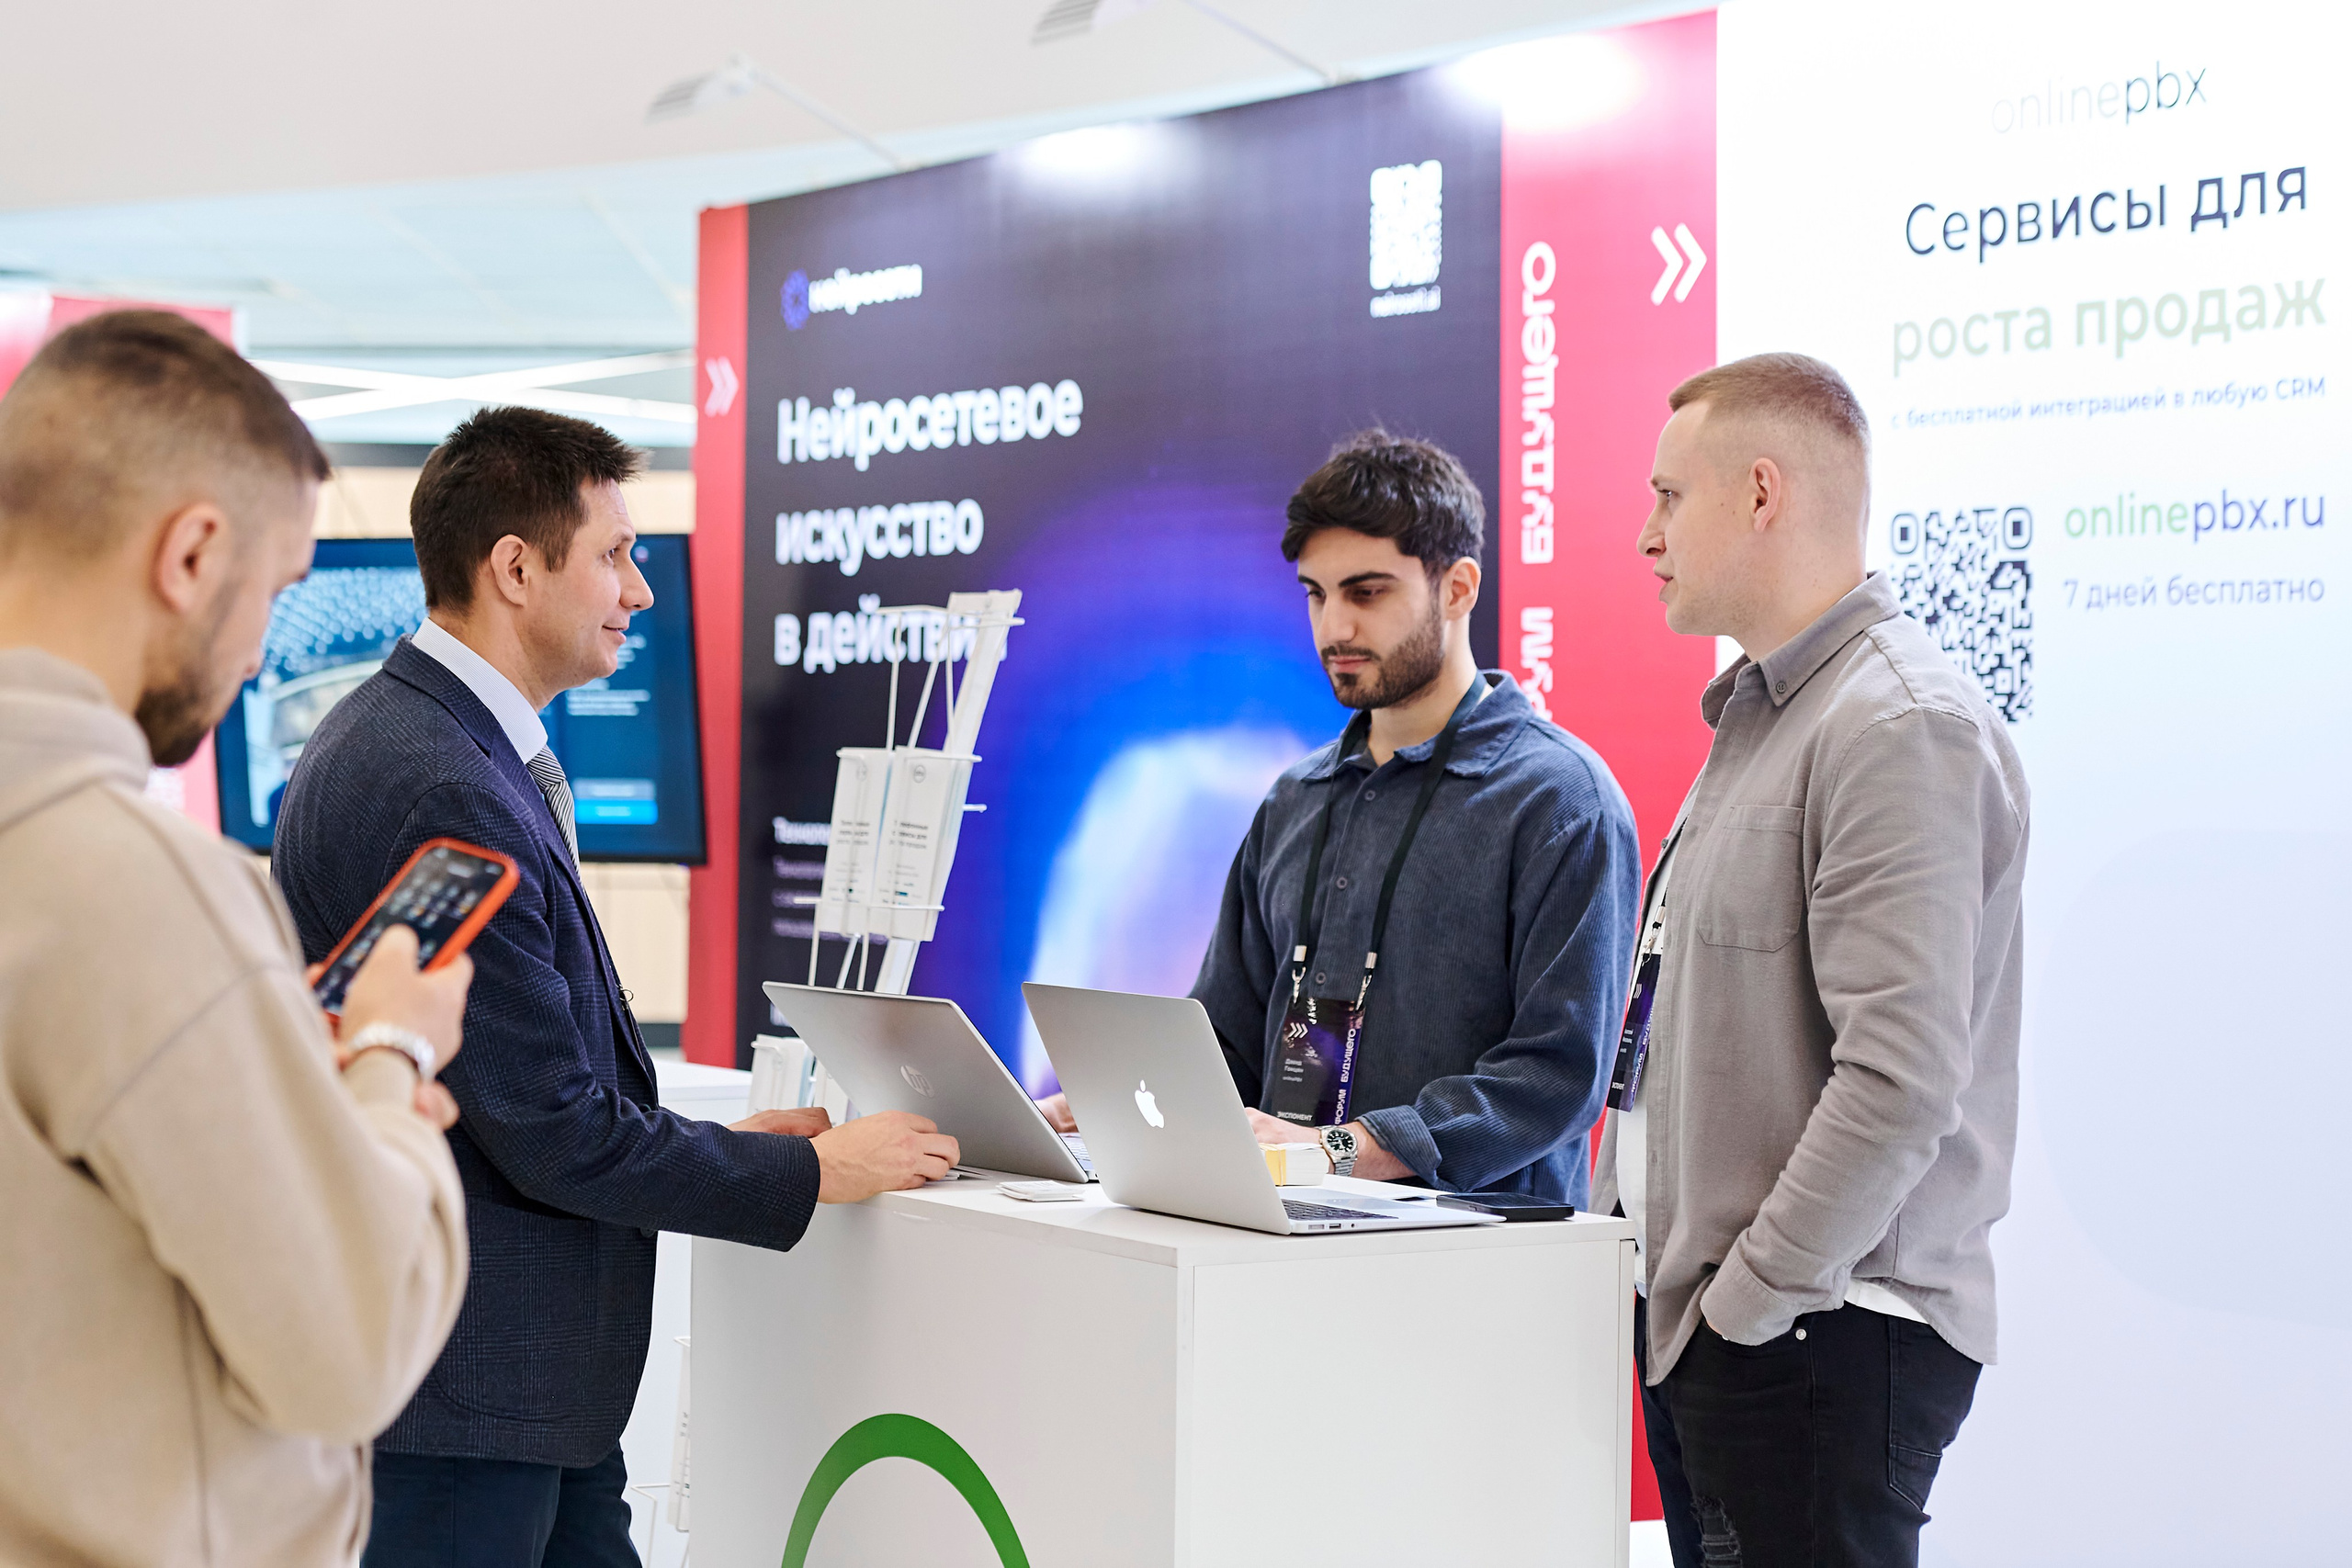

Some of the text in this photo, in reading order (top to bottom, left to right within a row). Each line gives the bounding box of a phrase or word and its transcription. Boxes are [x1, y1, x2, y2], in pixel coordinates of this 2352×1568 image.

[1991, 60, 2207, 133] onlinepbx
[1905, 166, 2306, 265] Сервисы для
[1894, 277, 2327, 378] роста продаж
[777, 379, 1084, 471] Нейросетевое
[1891, 376, 2326, 429] с бесплатной интеграцией в любую CRM
[775, 498, 985, 577] искусство
[2064, 489, 2326, 543] onlinepbx.ru
[2064, 574, 2326, 612] 7 дней бесплатно
[775, 593, 1008, 674] в действи
[1521, 606, 1554, 723] РУМ
[900, 1065, 934, 1098] hp
